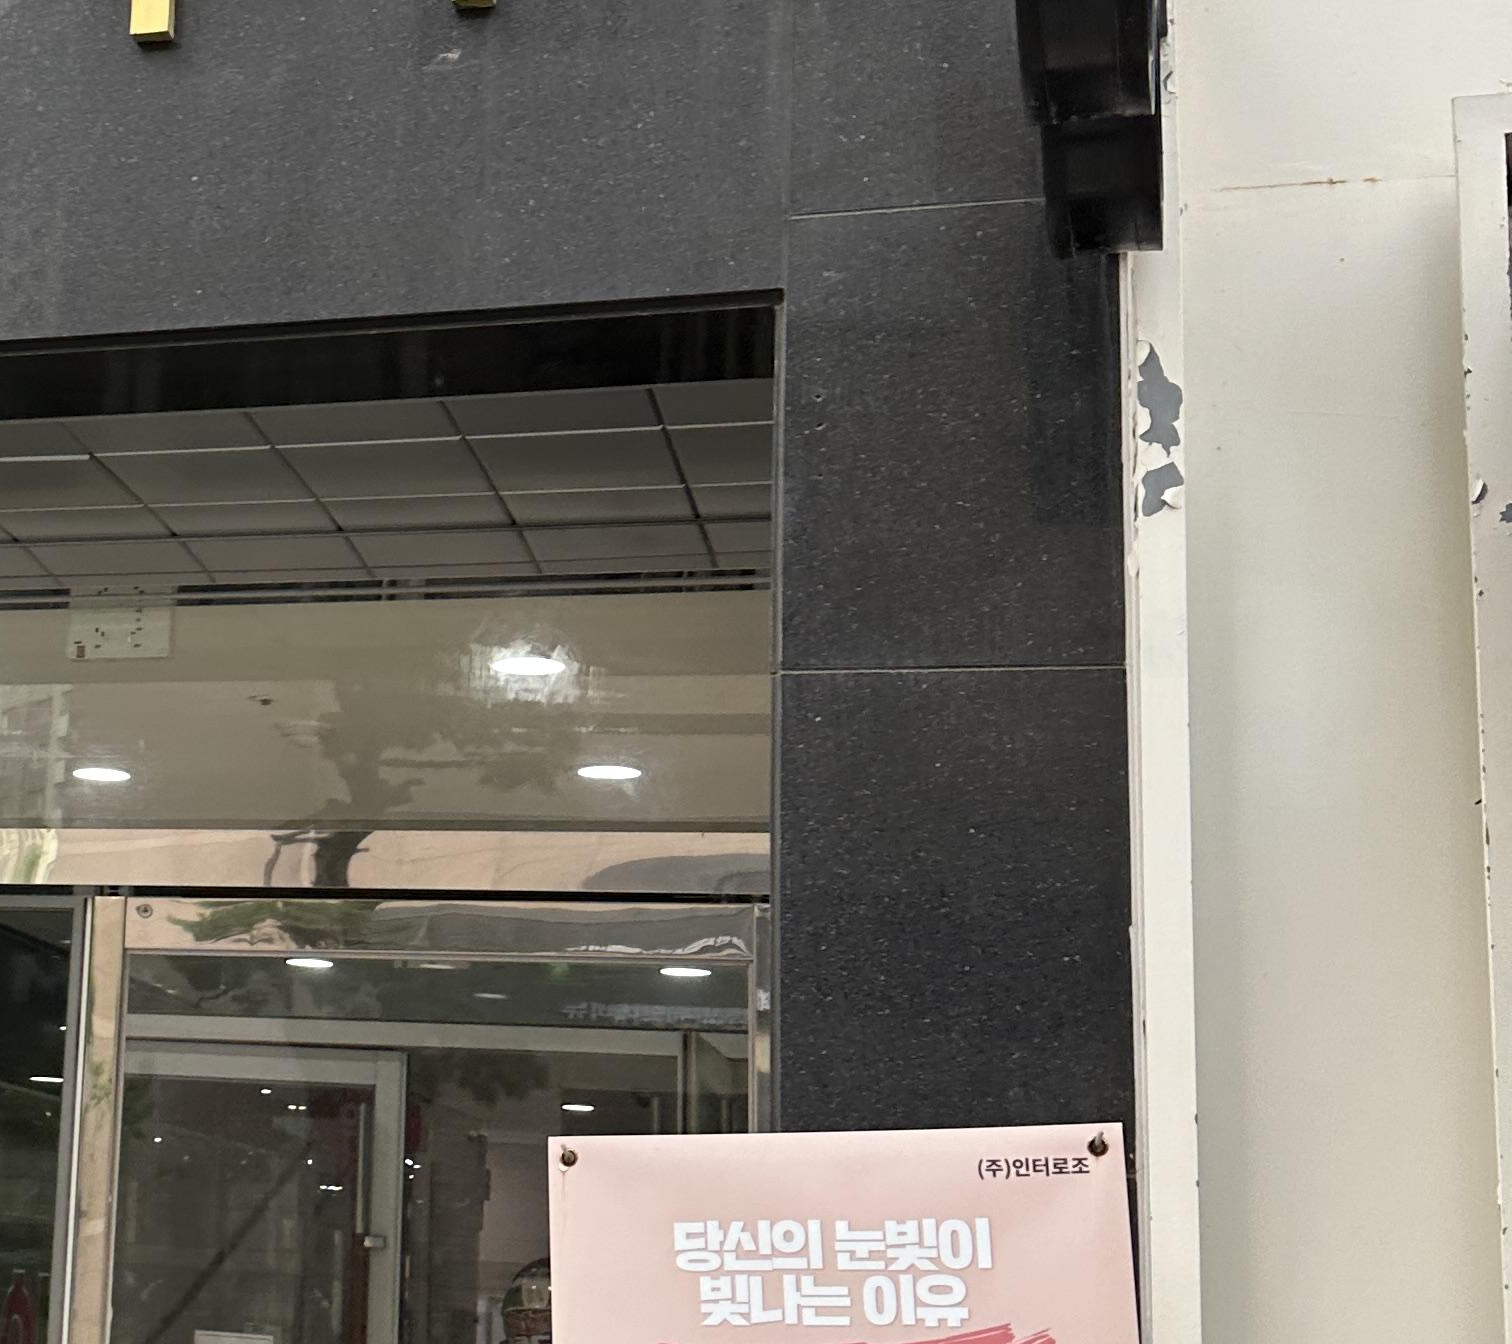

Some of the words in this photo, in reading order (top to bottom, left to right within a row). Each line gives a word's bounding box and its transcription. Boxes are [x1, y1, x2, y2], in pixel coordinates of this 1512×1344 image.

[977, 1157, 1090, 1180] (주)인터로조
[674, 1219, 822, 1272] 당신의
[834, 1217, 992, 1272] 눈빛이
[700, 1275, 850, 1326] 빛나는
[863, 1275, 969, 1327] 이유
